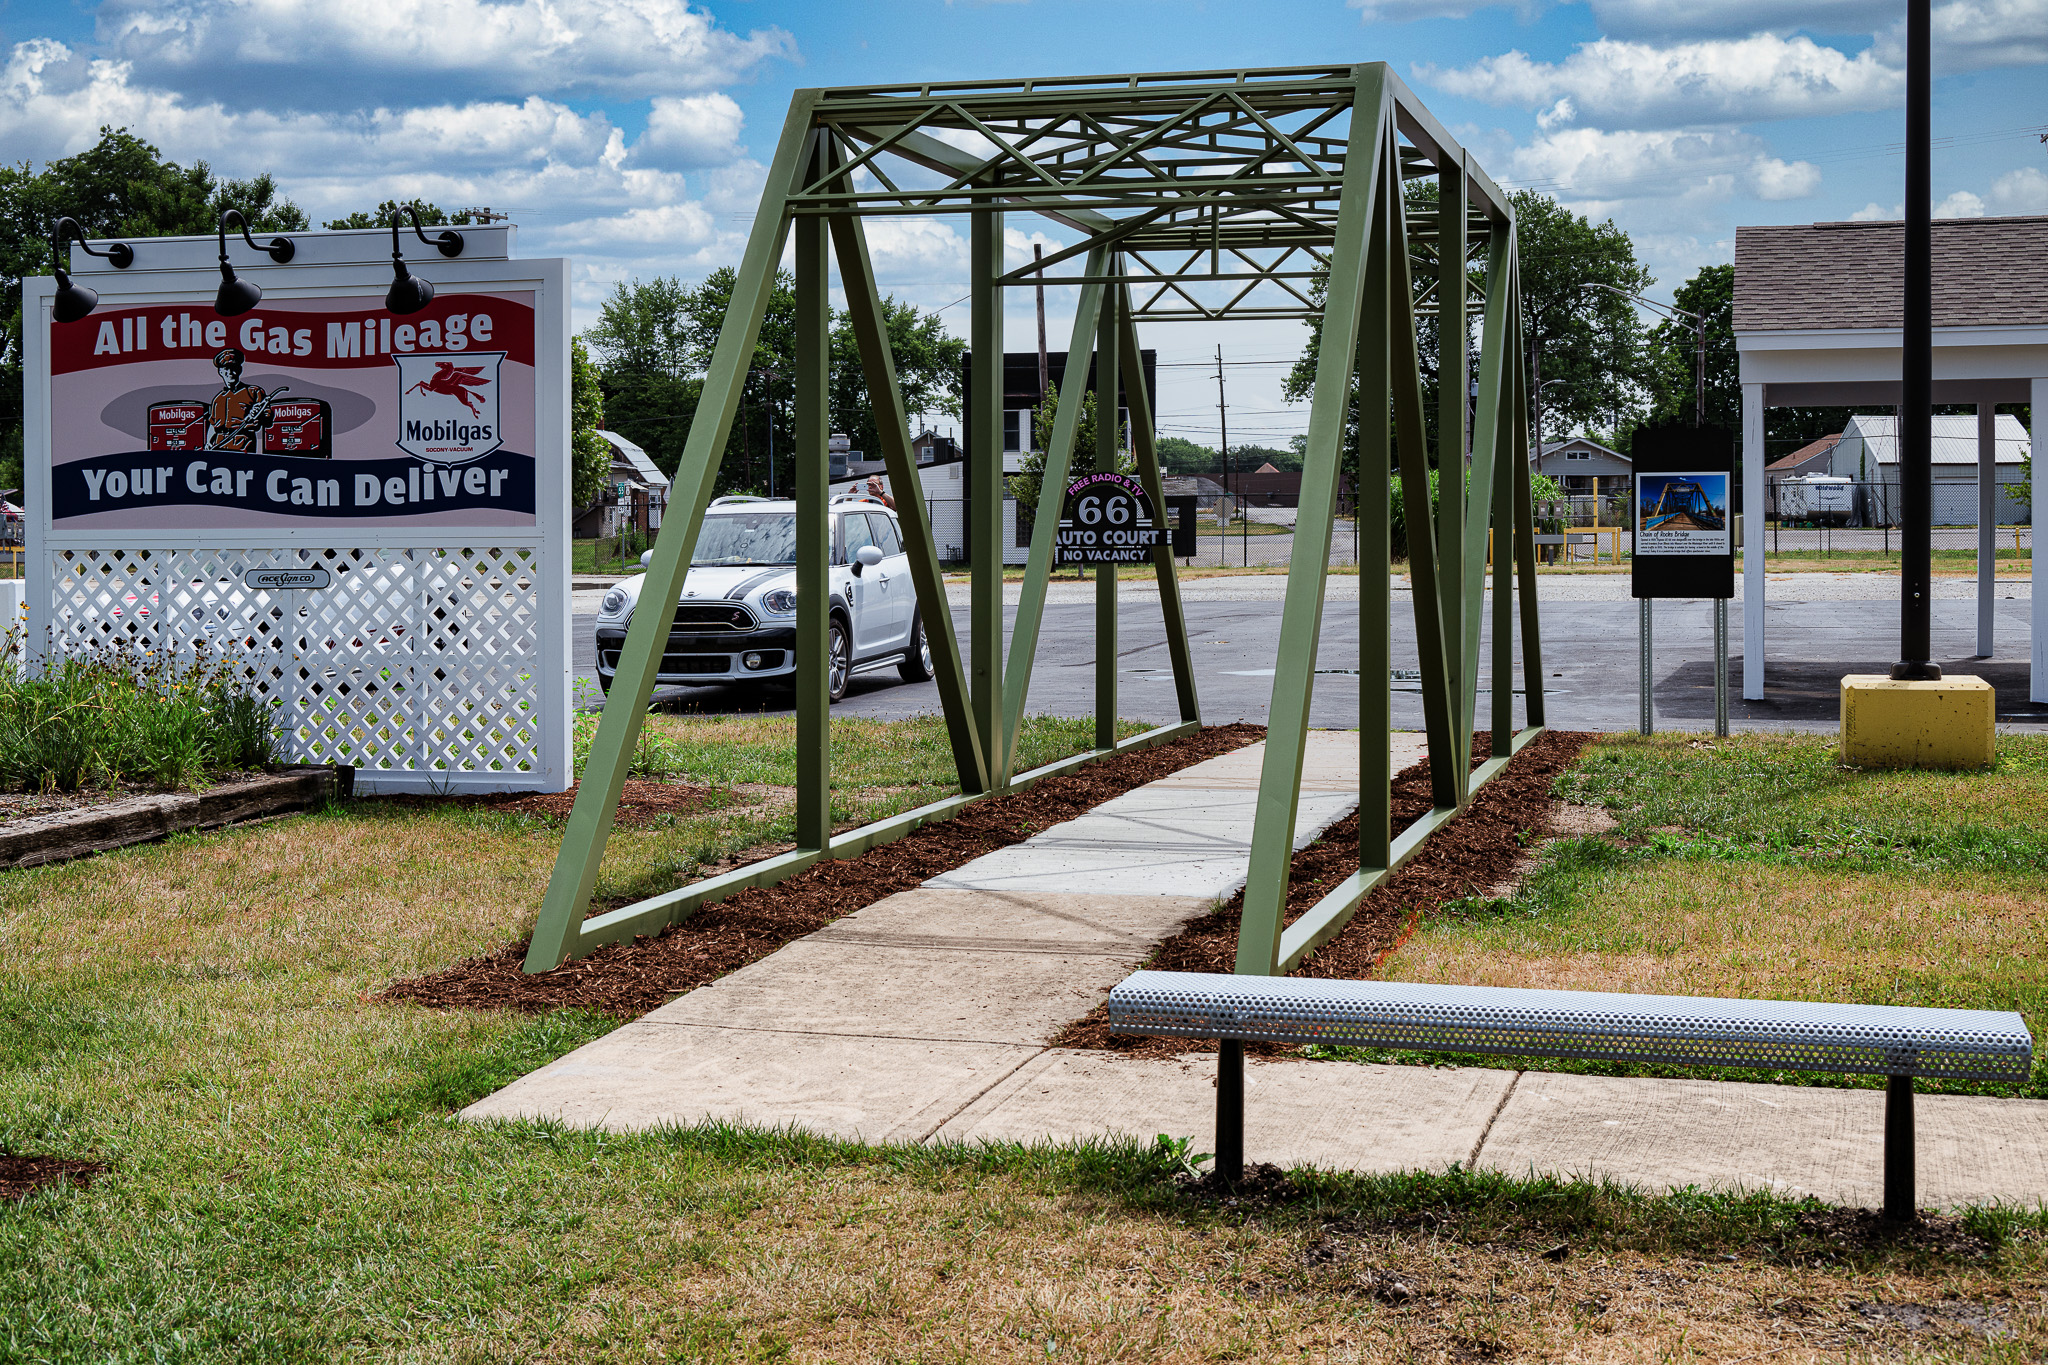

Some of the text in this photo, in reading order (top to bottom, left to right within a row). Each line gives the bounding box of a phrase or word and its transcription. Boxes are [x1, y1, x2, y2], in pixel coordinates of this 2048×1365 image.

[93, 313, 493, 358] All the Gas Mileage
[159, 408, 196, 421] Mobilgas
[274, 406, 312, 419] Mobilgas
[407, 419, 493, 446] Mobilgas
[82, 461, 509, 507] Your Car Can Deliver
[1068, 473, 1144, 496] FREE RADIO & TV
[1078, 496, 1129, 525] 66
[1102, 530, 1159, 545] COURT
[1063, 550, 1146, 561] NO VACANCY
[276, 572, 298, 586] Sign
